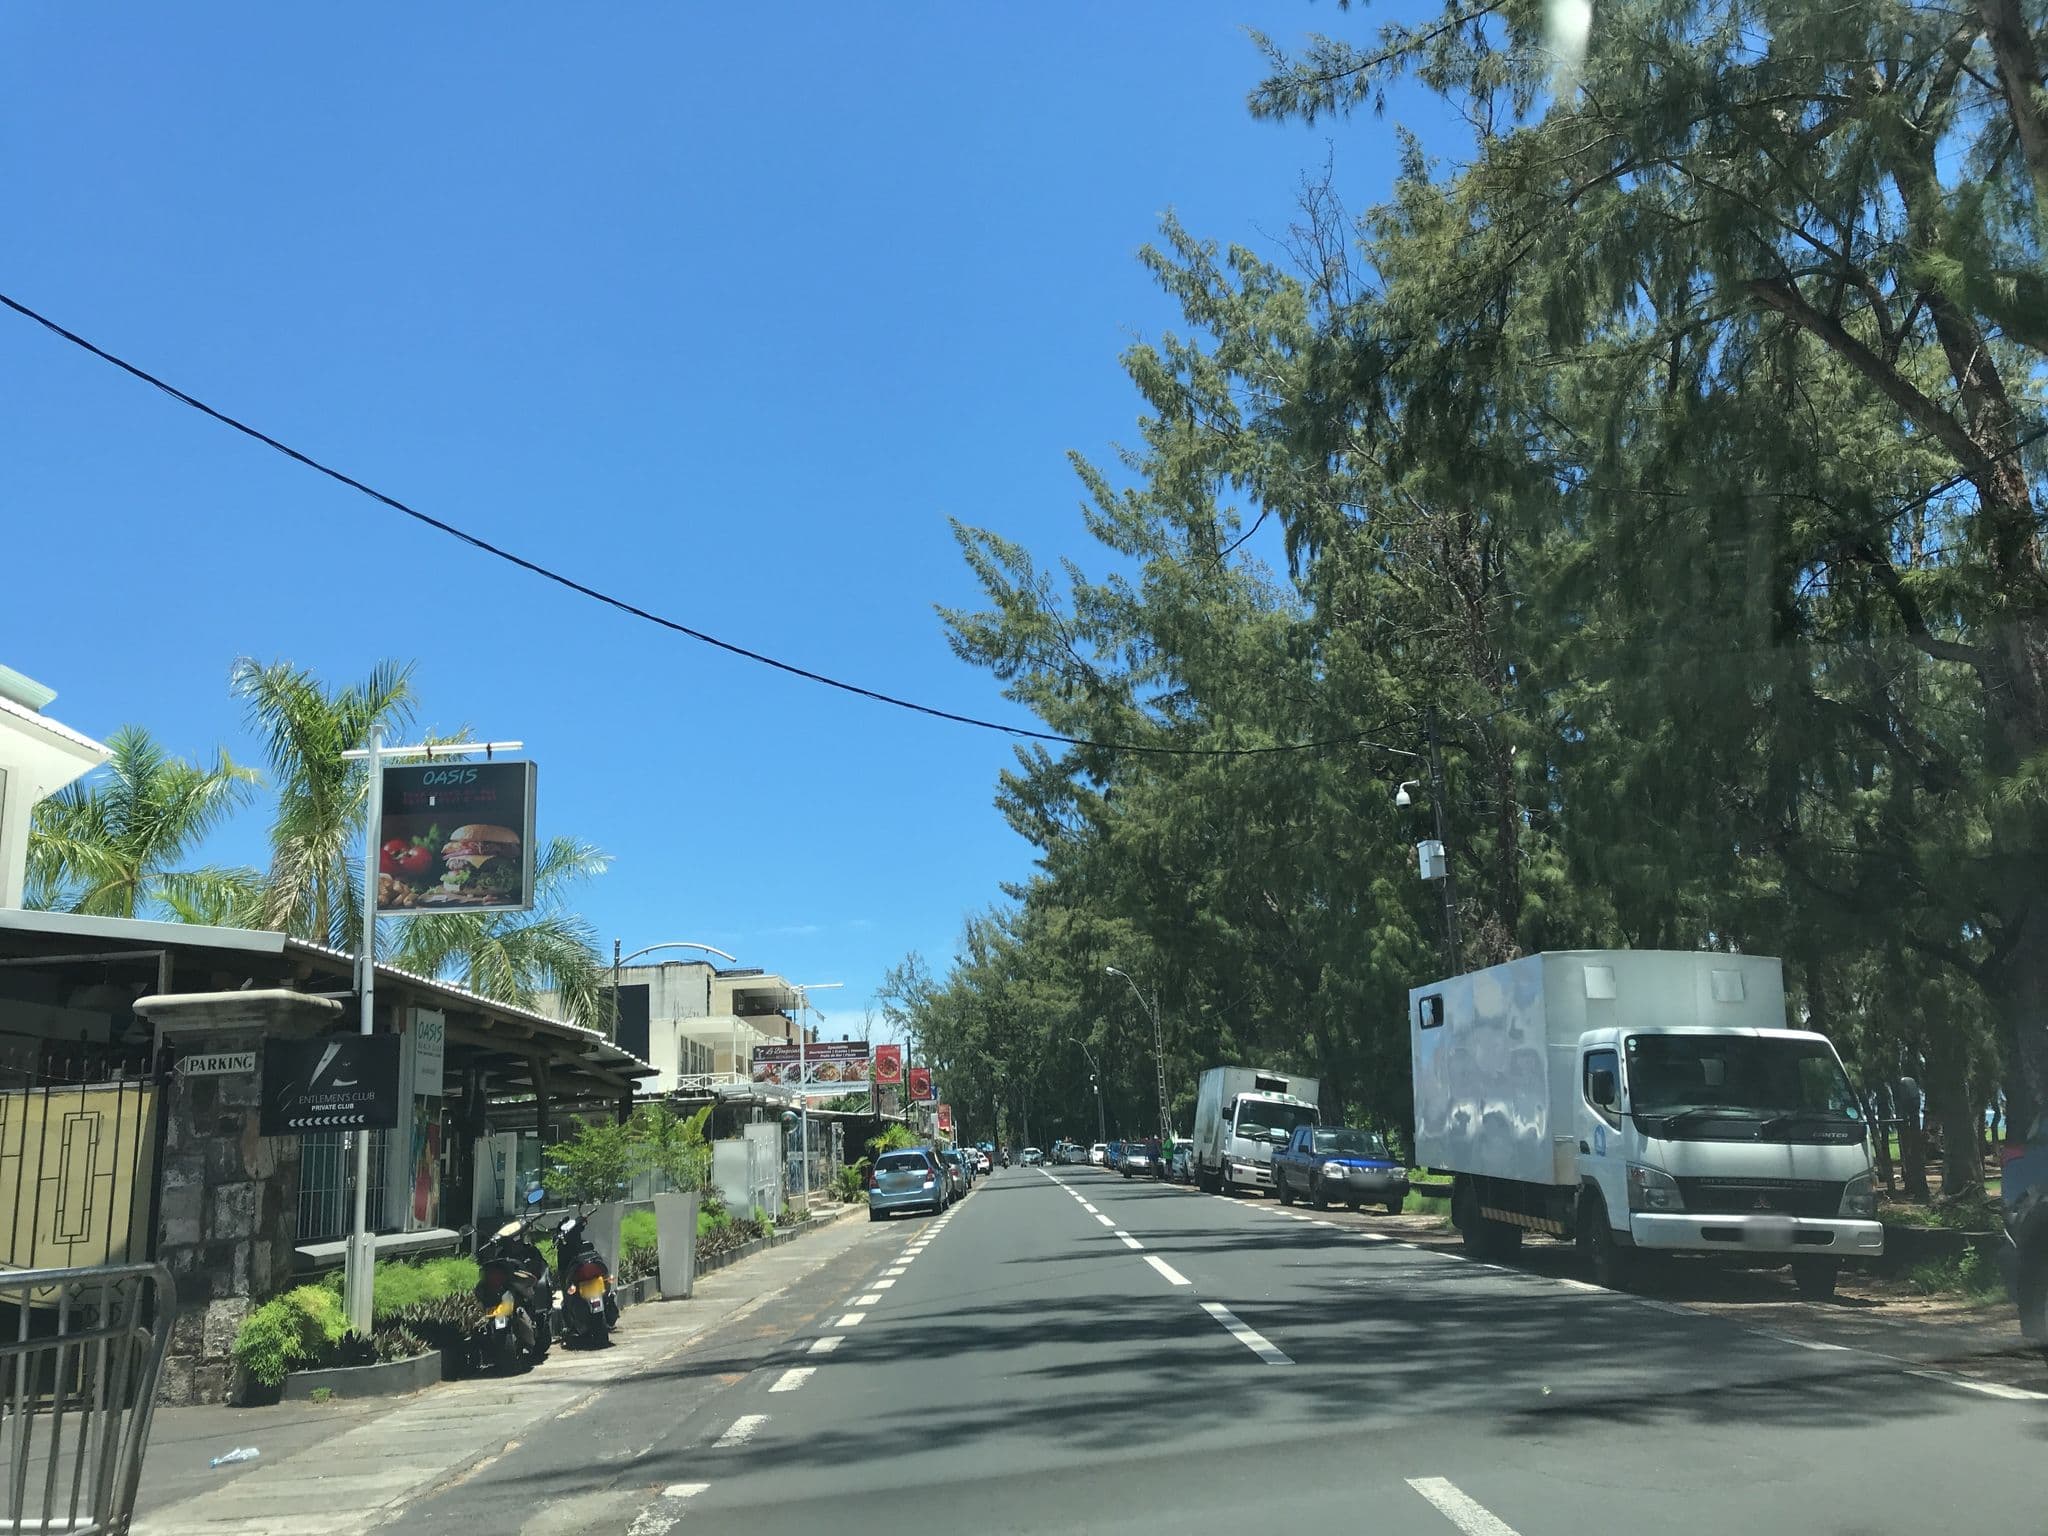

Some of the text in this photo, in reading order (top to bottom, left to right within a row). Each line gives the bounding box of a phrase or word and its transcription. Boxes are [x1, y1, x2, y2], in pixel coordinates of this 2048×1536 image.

[423, 768, 479, 785] OASIS
[418, 1022, 443, 1043] OASIS
[189, 1054, 253, 1072] PARKING
[352, 1091, 377, 1102] CLUB
[311, 1102, 355, 1112] PRIVATE CLUB
